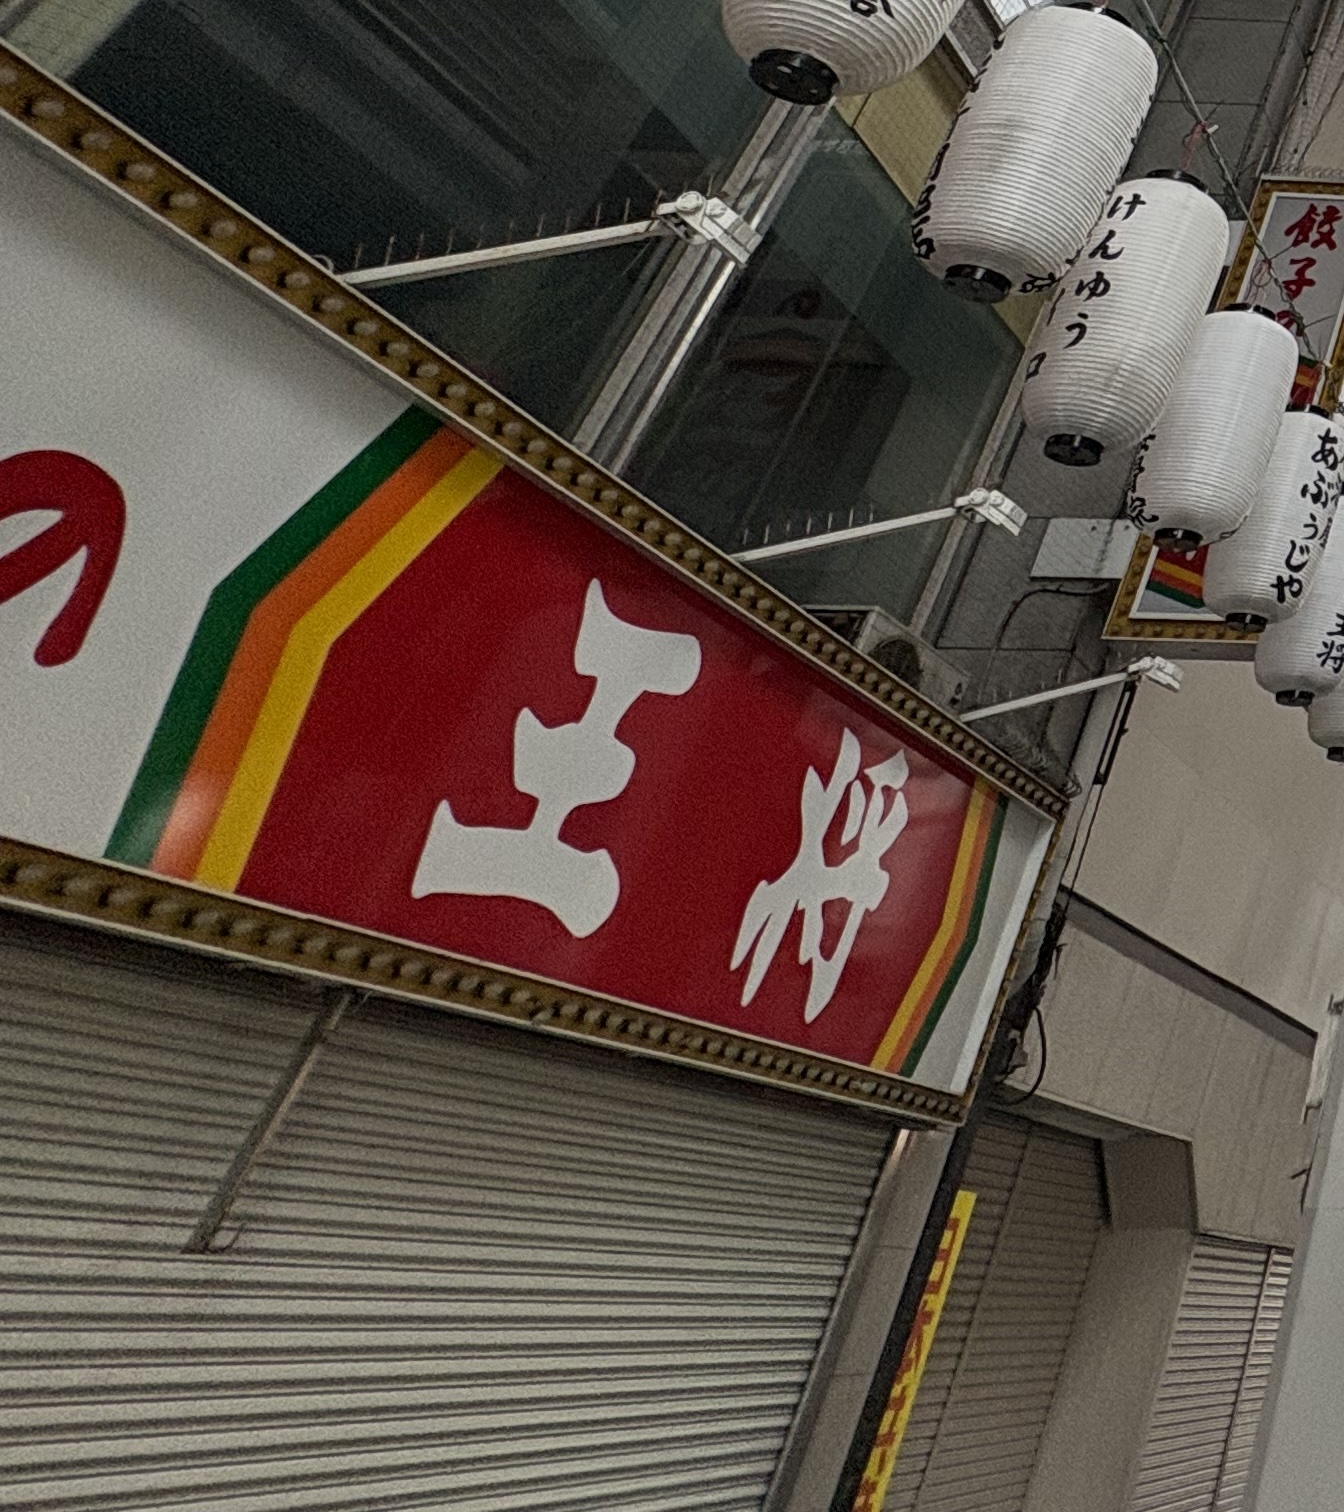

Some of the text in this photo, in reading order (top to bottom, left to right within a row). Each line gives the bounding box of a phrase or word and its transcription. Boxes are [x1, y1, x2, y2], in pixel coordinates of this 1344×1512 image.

[1062, 193, 1146, 350] けんゆう
[411, 577, 910, 1025] 王将
